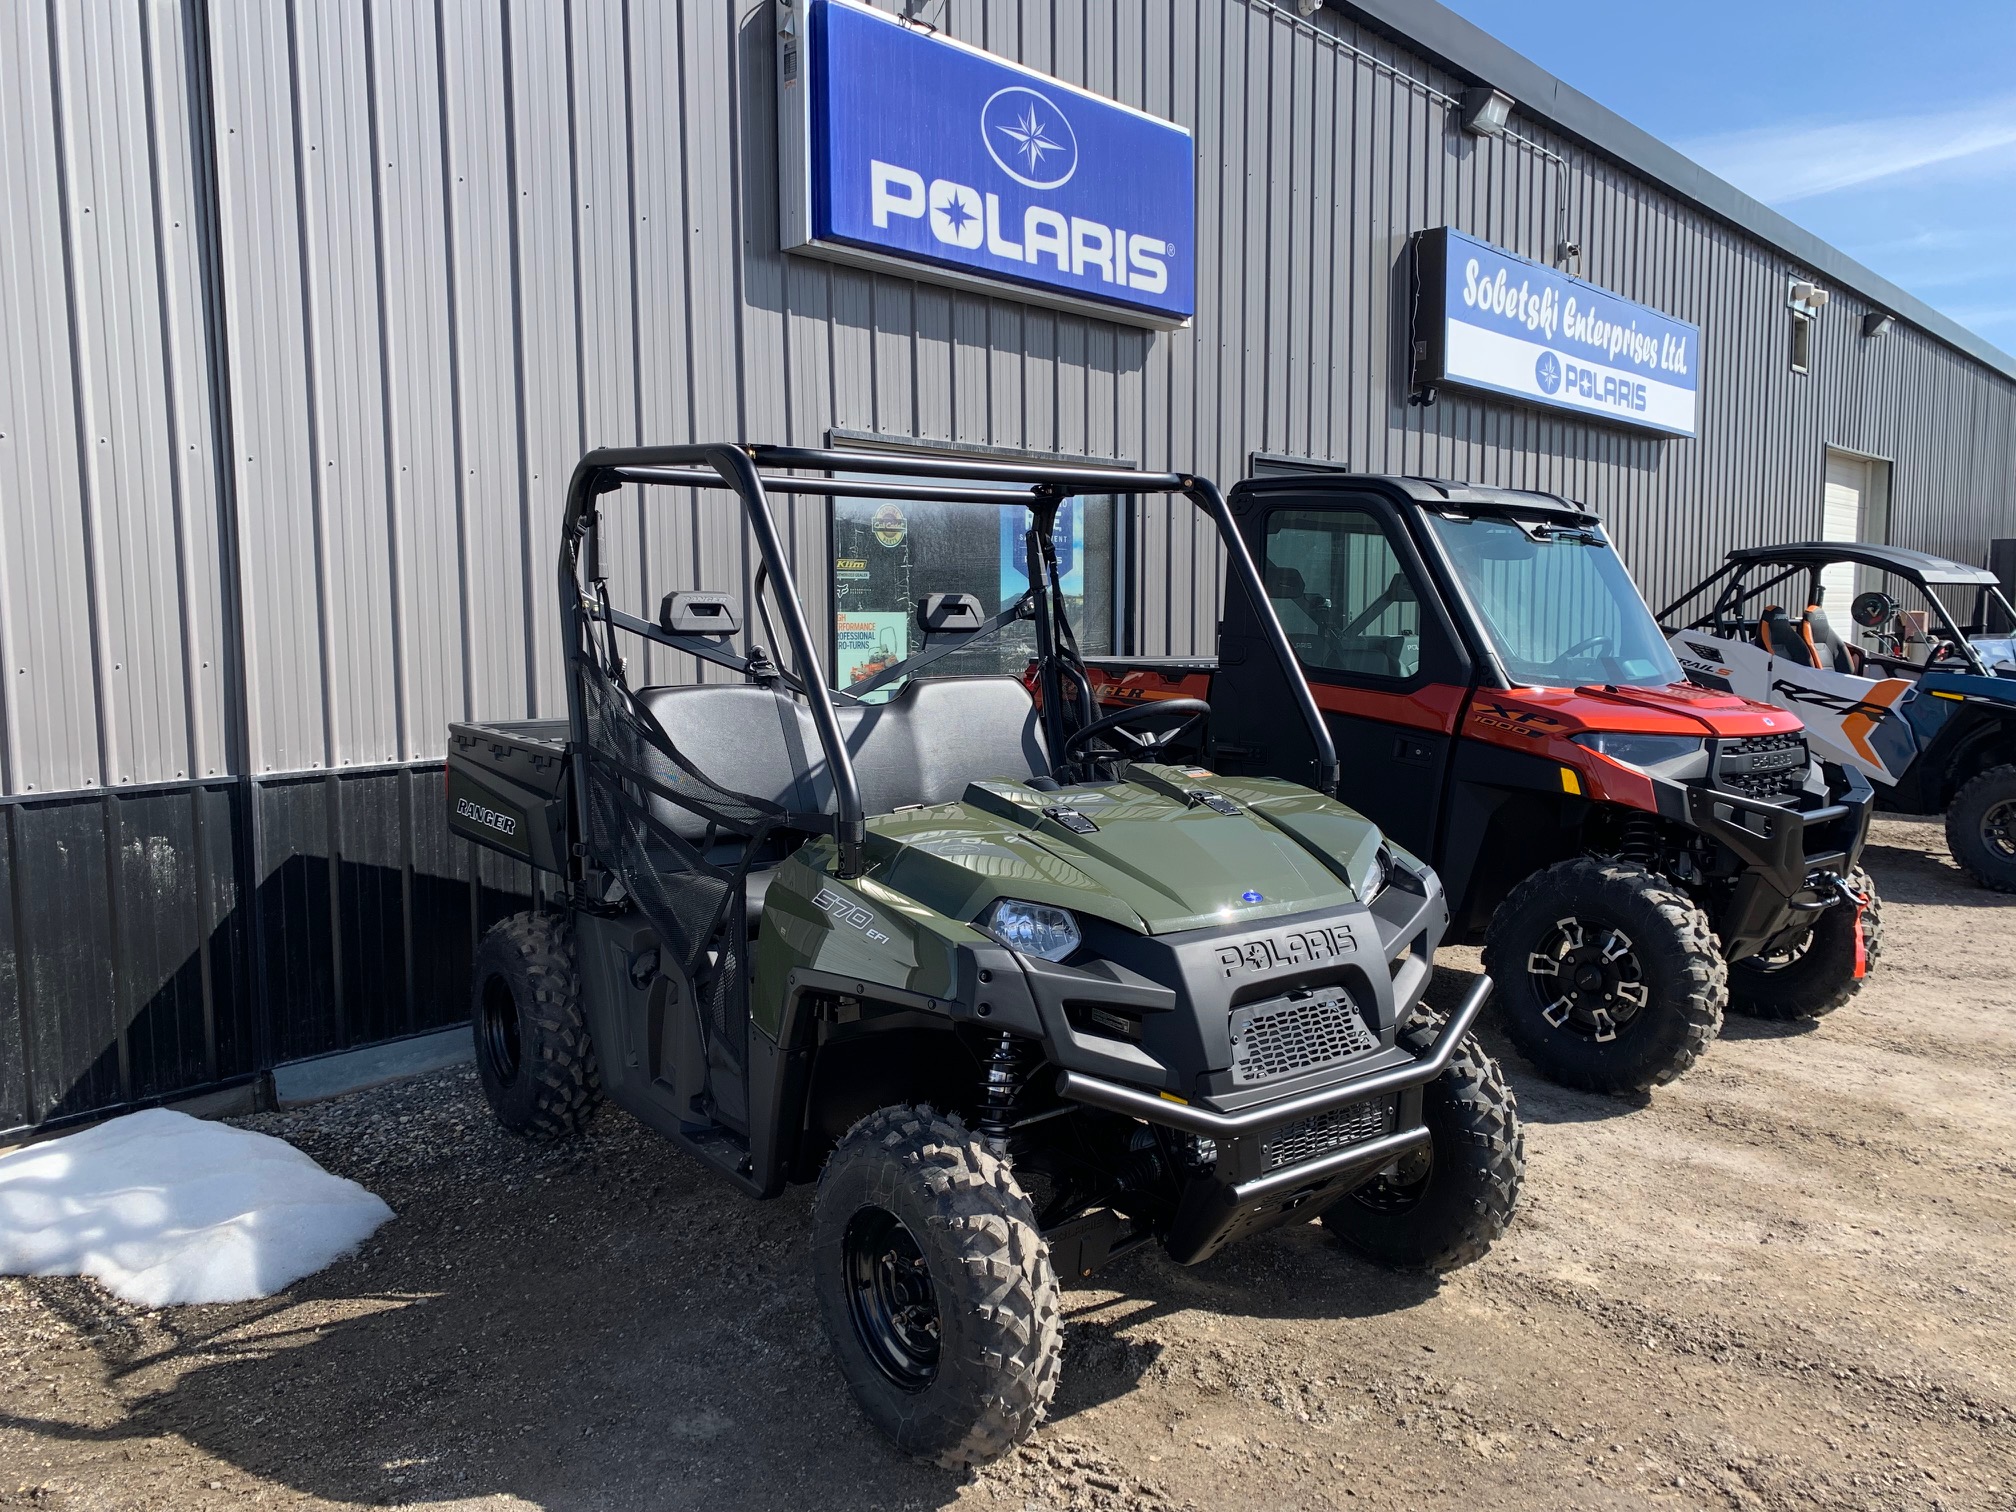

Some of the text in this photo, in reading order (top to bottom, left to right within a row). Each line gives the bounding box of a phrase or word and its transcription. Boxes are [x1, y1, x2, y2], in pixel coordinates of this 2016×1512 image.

[870, 158, 1168, 295] POLARIS
[1463, 258, 1687, 375] Sobetski Enterprises Ltd.
[1566, 363, 1647, 412] POLARIS
[836, 560, 866, 569] Klim
[1474, 715, 1531, 735] 1000
[456, 798, 516, 836] RANGER
[812, 888, 890, 944] 570 EFI
[1215, 925, 1358, 978] POLARIS
